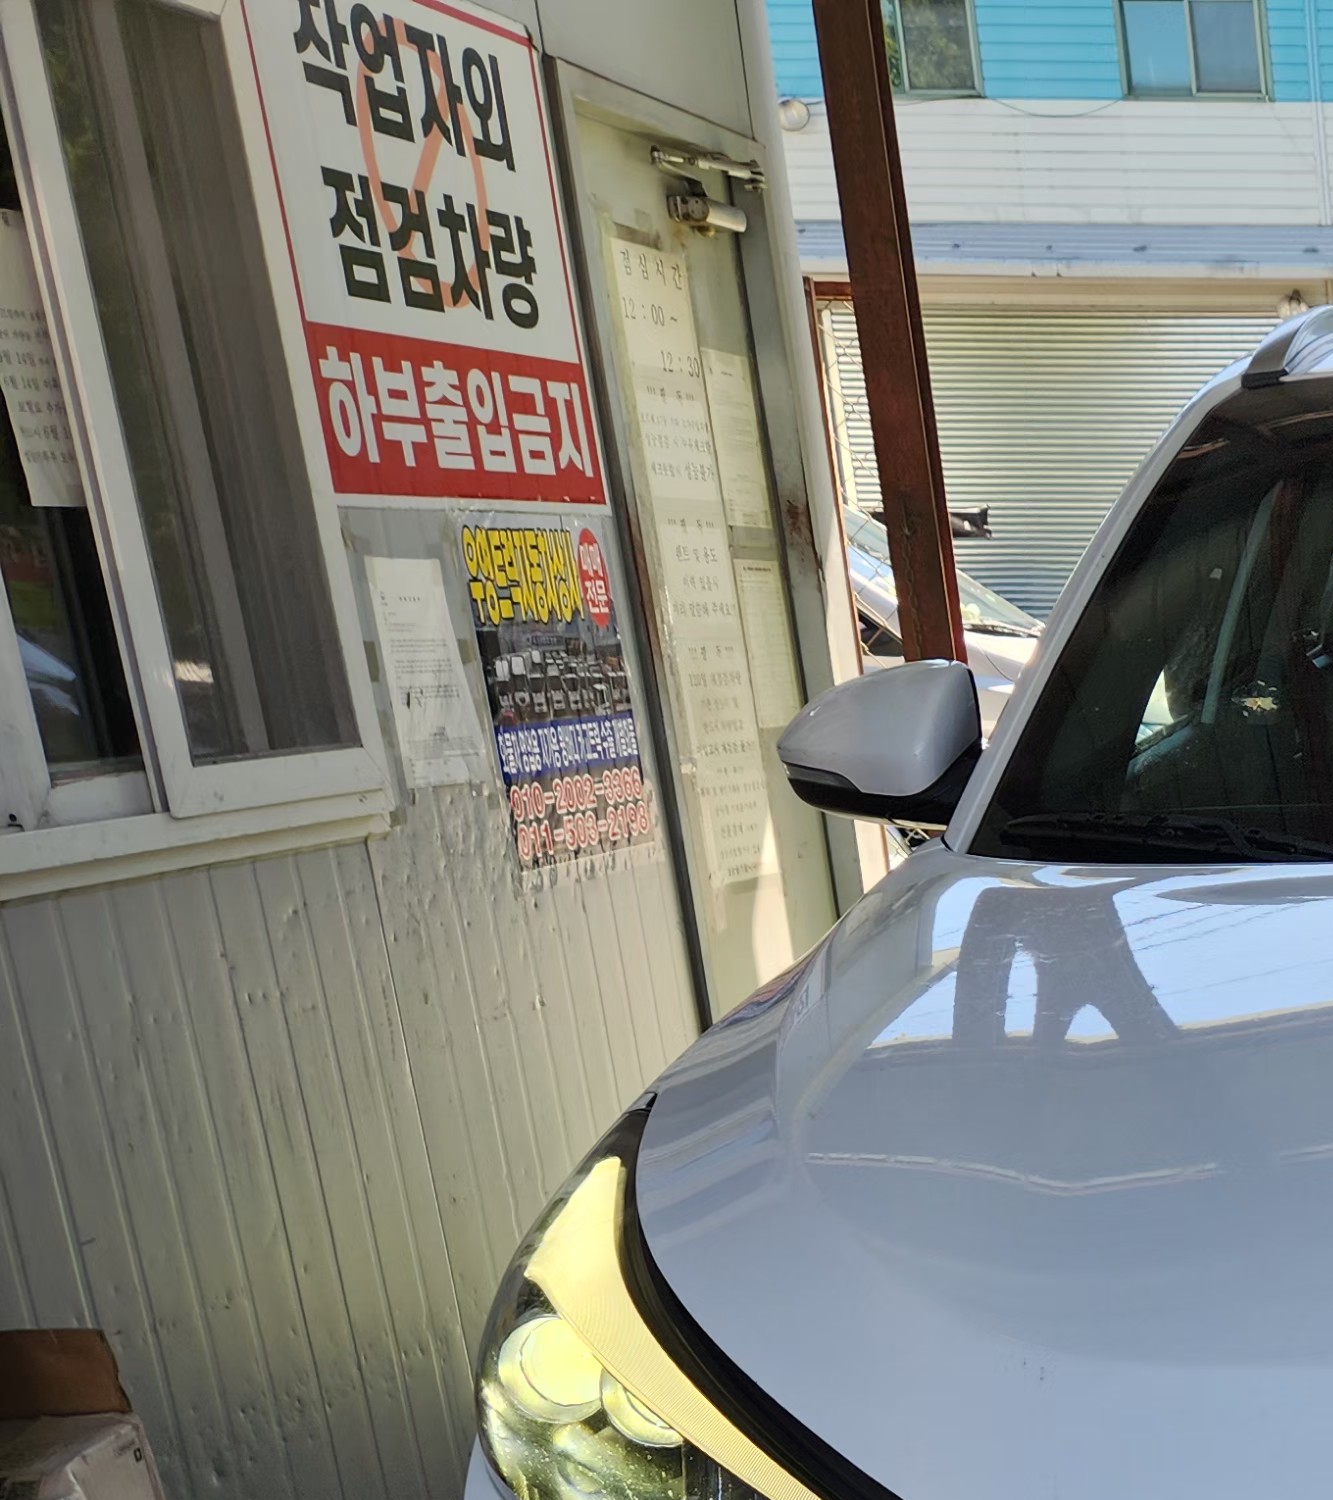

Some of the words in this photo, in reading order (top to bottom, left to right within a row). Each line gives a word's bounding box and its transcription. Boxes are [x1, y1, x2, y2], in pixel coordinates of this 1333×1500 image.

[320, 165, 540, 330] 점검차량
[318, 345, 594, 478] 하부출입금지
[579, 542, 604, 578] 매매
[584, 580, 610, 615] 전문
[510, 765, 643, 823] 010-2002-3366
[517, 800, 651, 861] 011-503-2198
